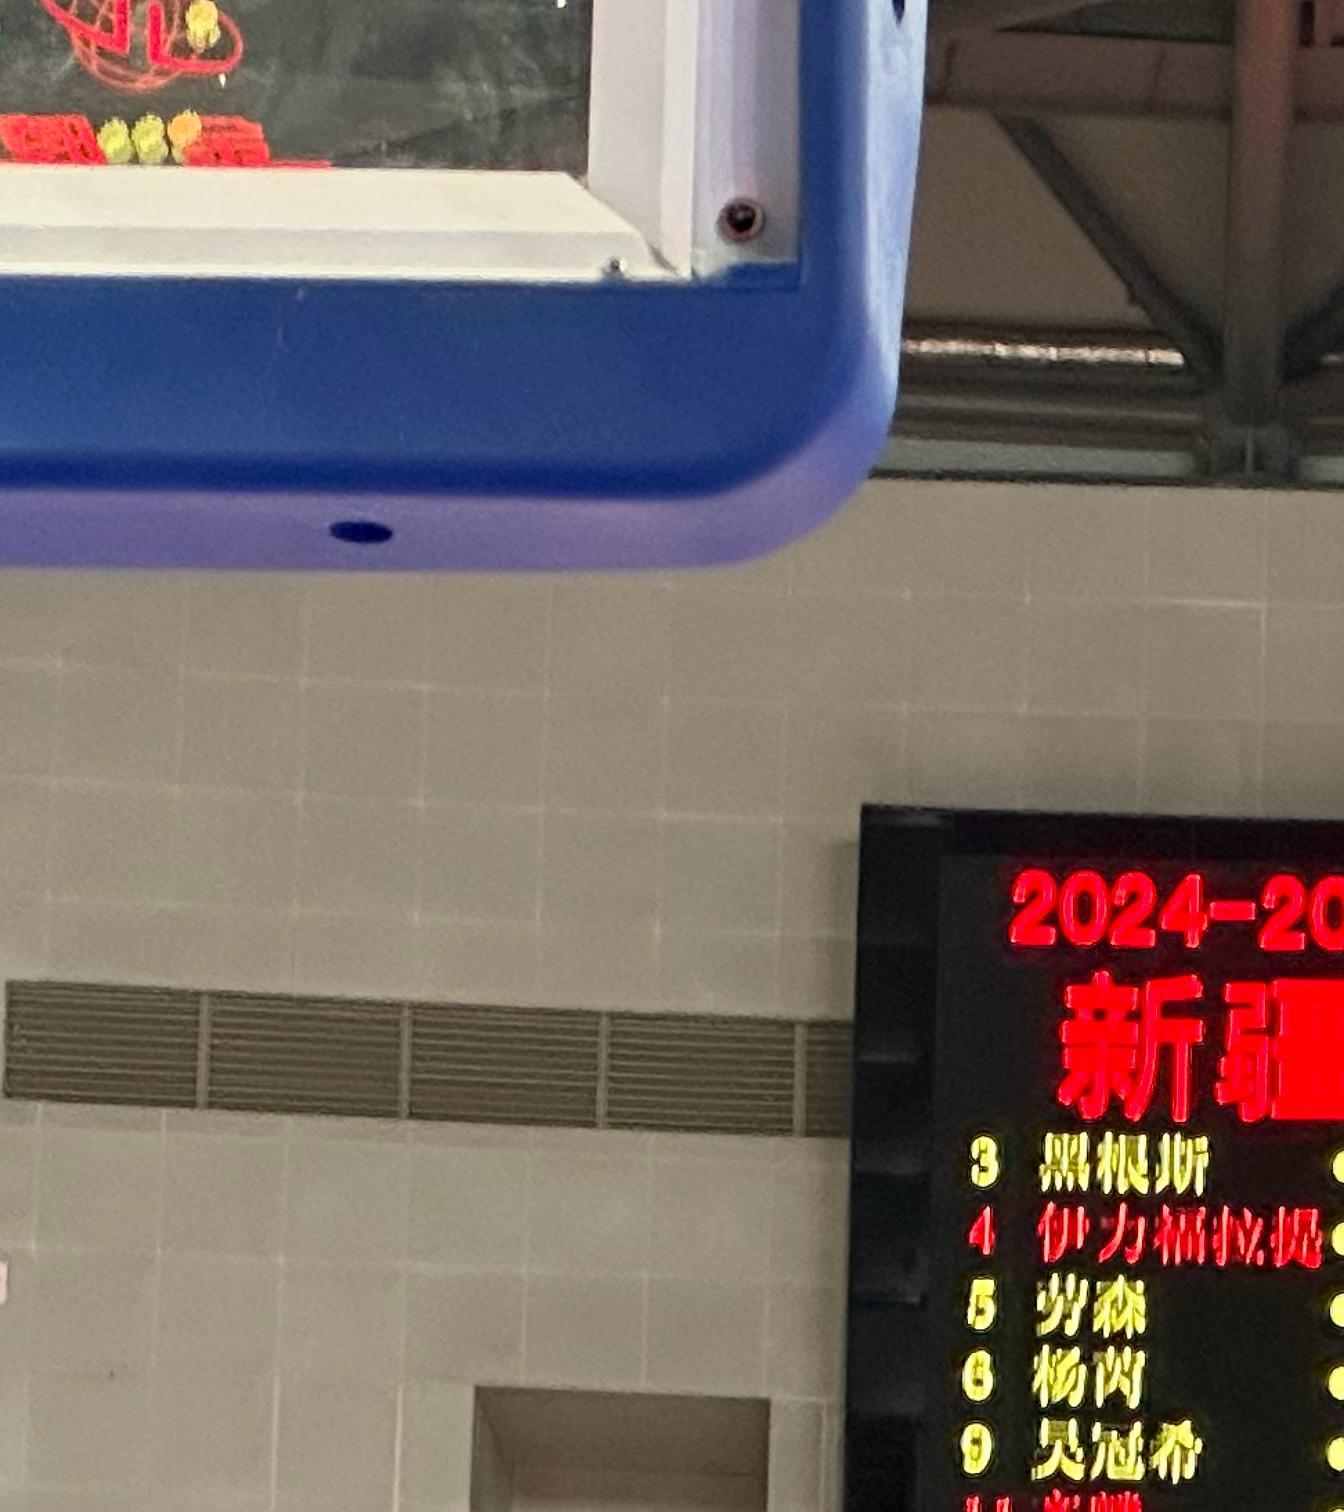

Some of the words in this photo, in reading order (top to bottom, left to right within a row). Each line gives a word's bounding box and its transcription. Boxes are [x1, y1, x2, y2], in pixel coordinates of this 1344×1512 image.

[971, 1136, 999, 1187] 3
[969, 1206, 995, 1255] 4
[967, 1279, 996, 1329] 5
